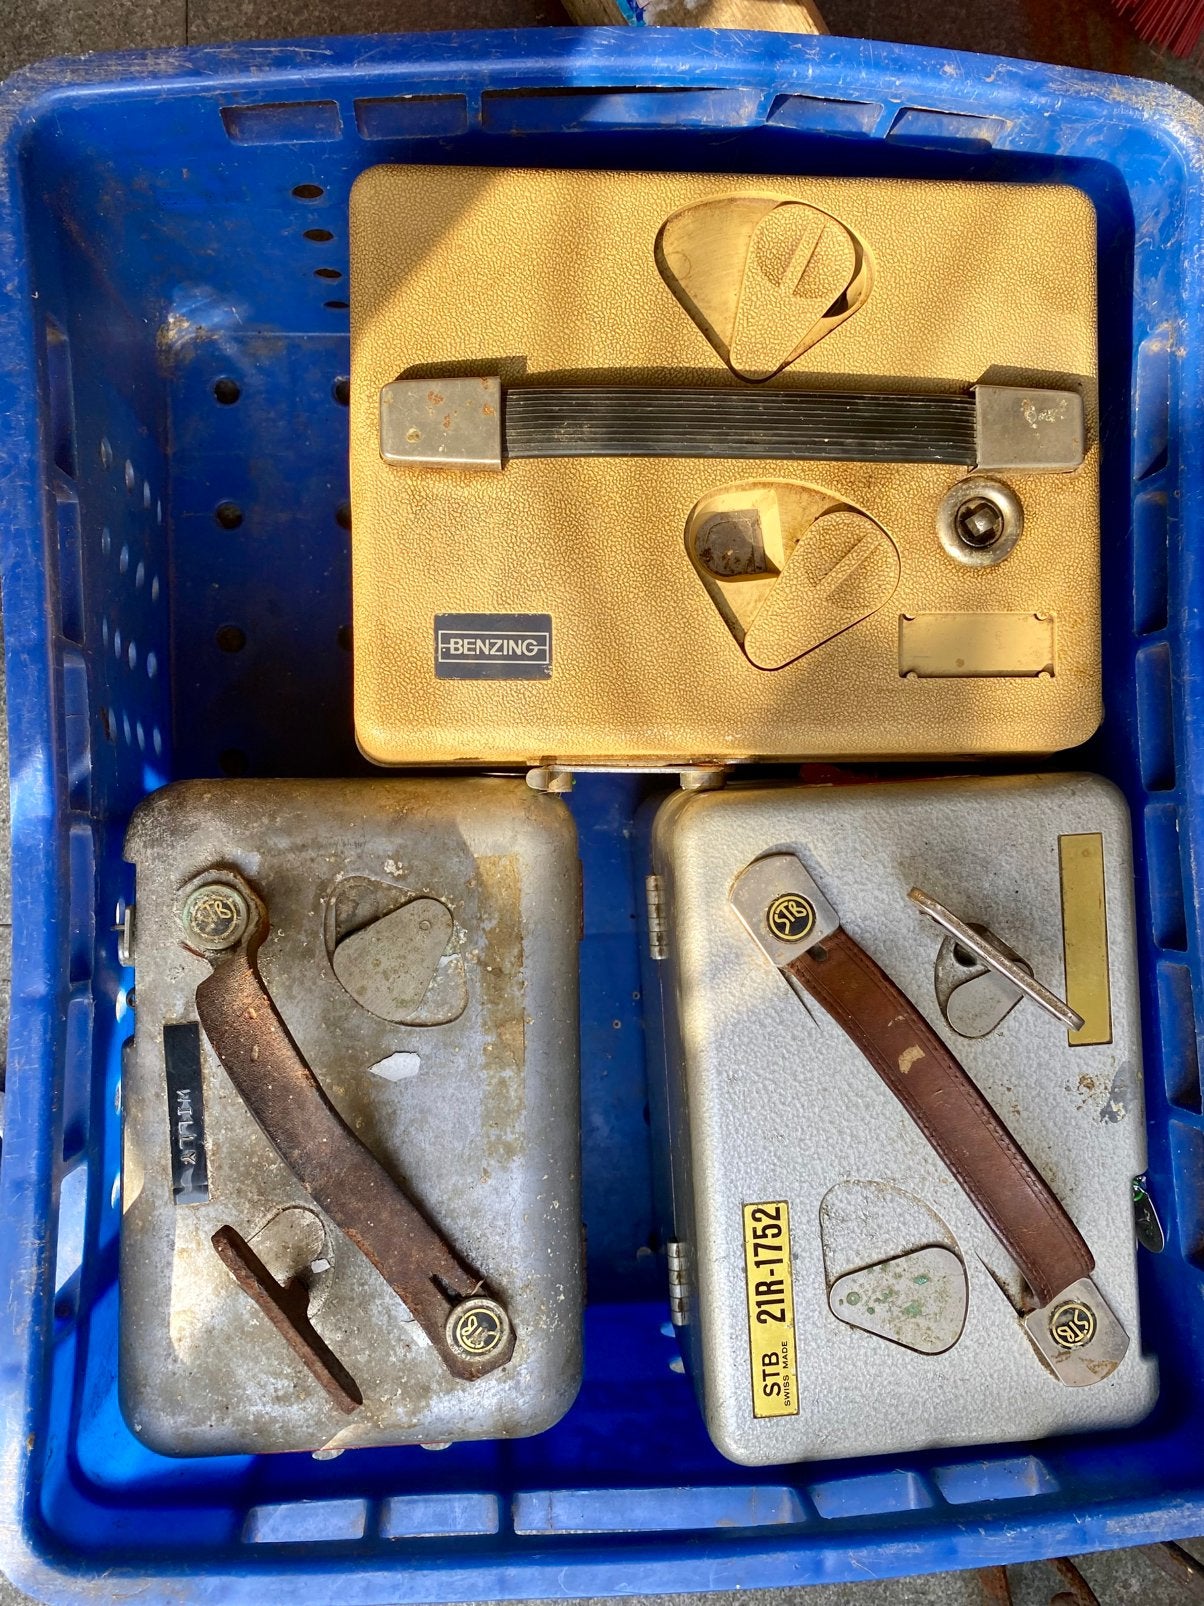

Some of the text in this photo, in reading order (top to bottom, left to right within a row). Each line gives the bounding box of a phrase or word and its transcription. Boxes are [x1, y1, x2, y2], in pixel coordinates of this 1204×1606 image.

[449, 638, 538, 656] BENZING
[774, 900, 808, 935] STB
[176, 1089, 197, 1165] WILLY
[751, 1206, 786, 1397] STB 21R-1752
[1057, 1309, 1089, 1342] STB
[783, 1374, 791, 1407] SWISS
